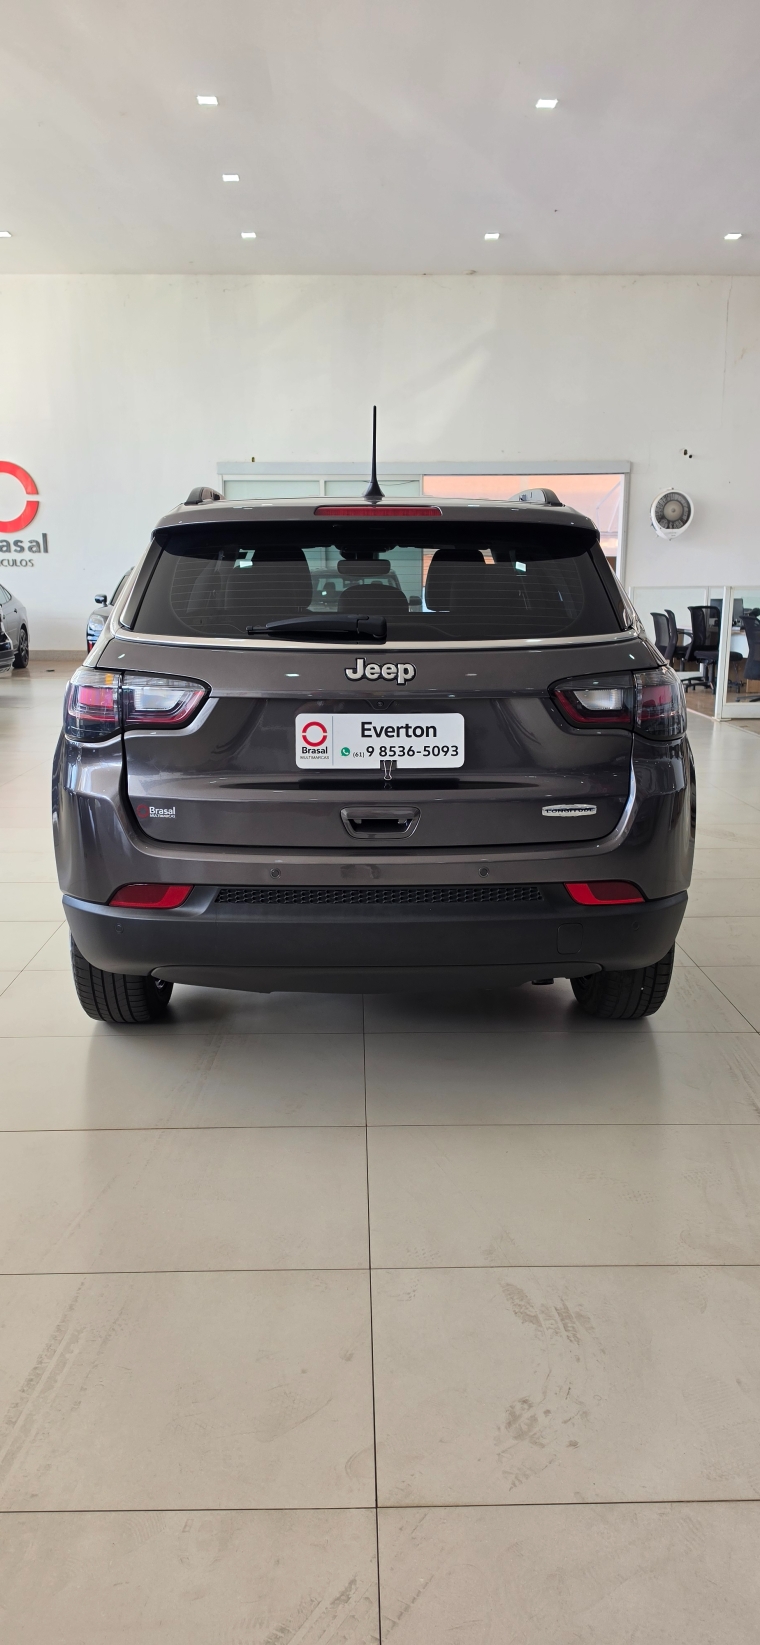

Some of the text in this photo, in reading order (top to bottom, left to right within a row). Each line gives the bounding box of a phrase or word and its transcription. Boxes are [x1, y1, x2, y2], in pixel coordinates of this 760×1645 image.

[345, 658, 416, 684] Jeep
[361, 721, 437, 738] Everton
[301, 746, 328, 755] Brasal
[366, 745, 375, 757] 9
[378, 745, 459, 757] 8536-5093
[149, 806, 175, 815] Brasal
